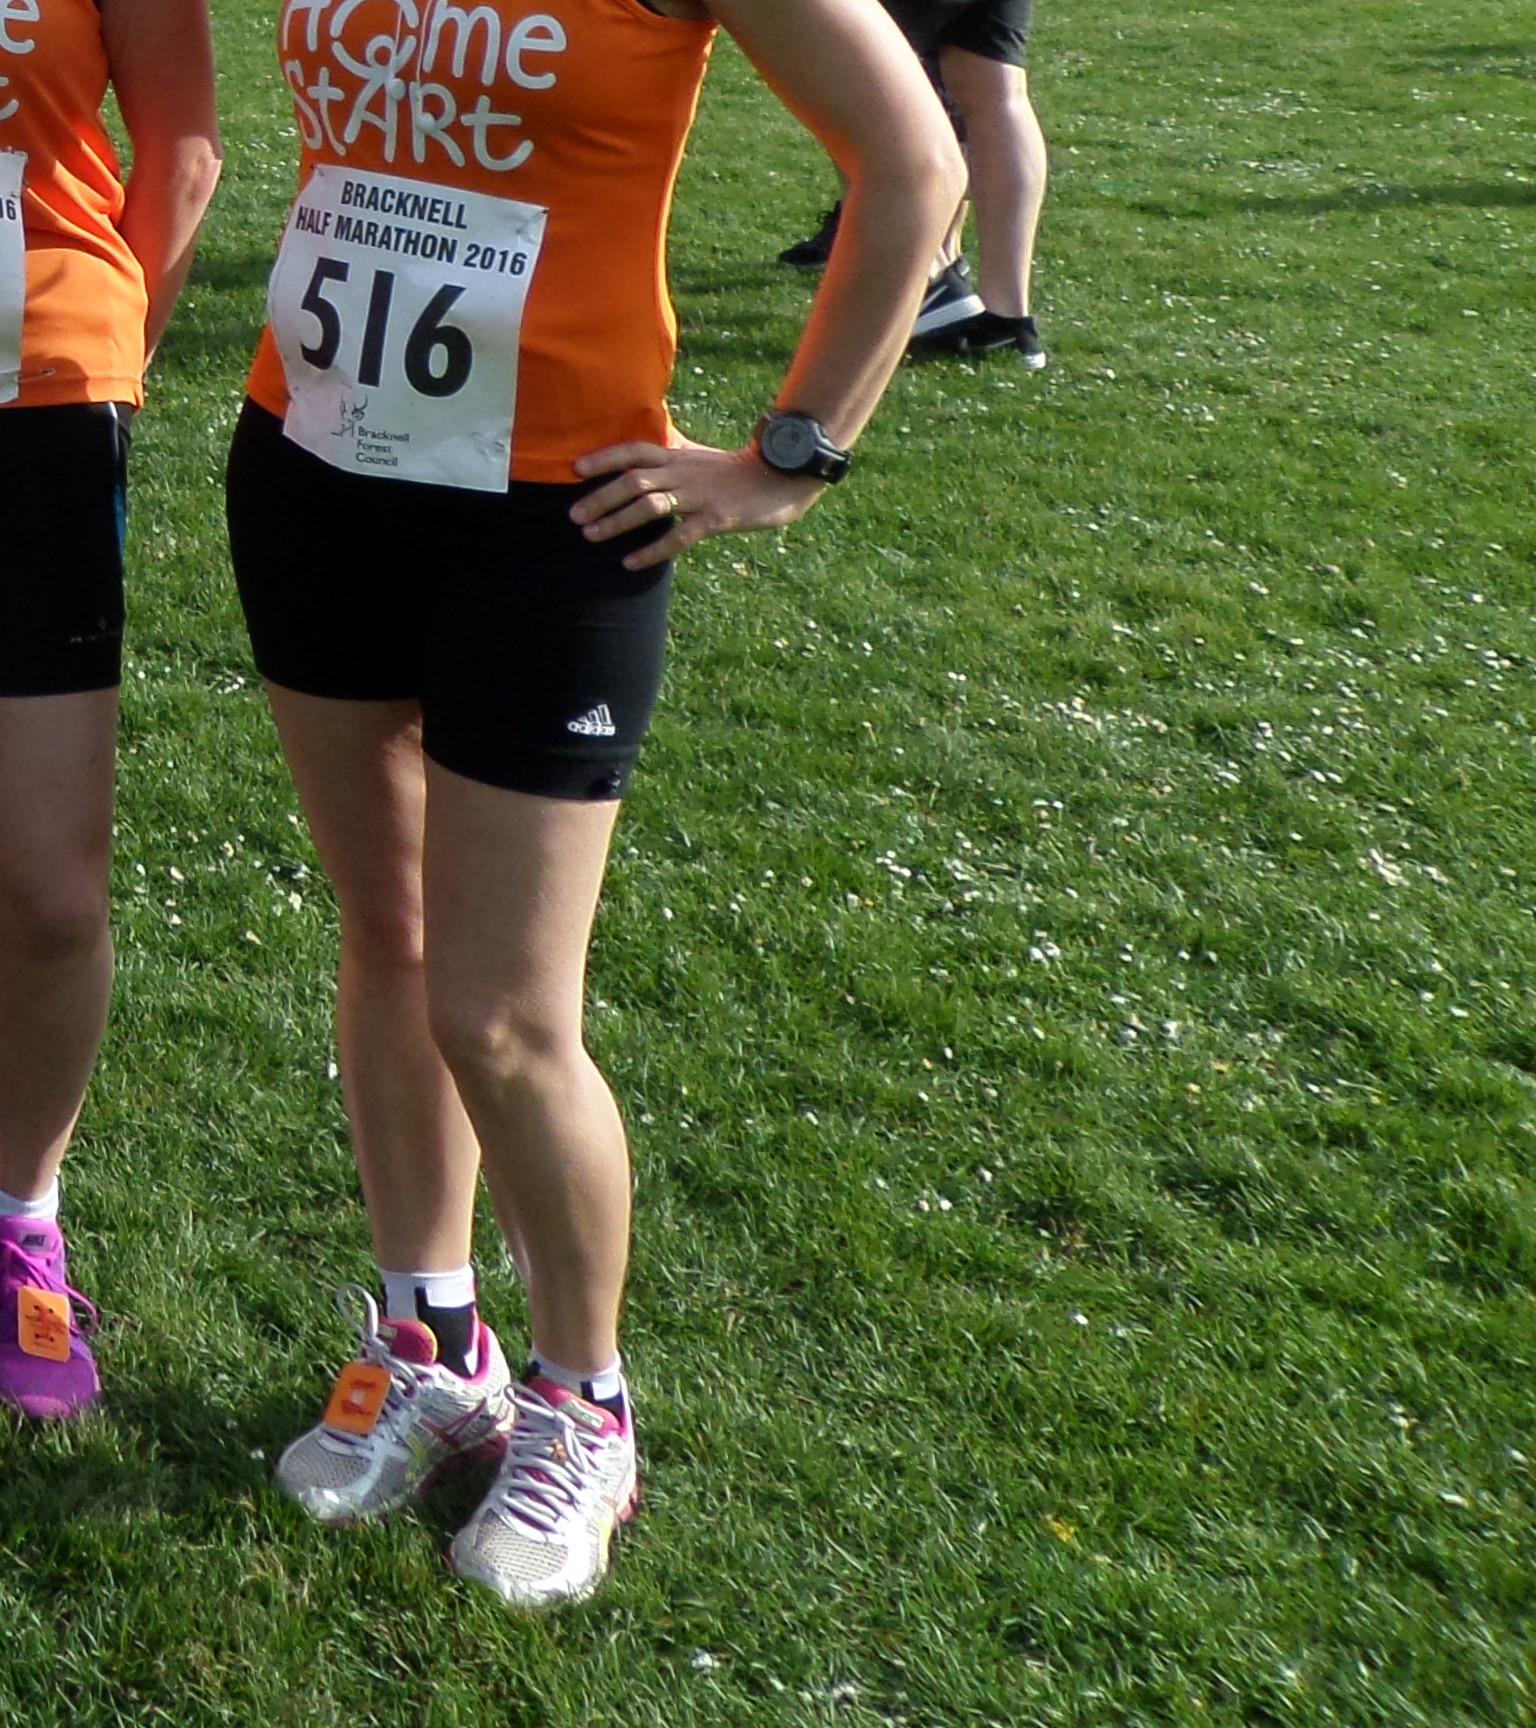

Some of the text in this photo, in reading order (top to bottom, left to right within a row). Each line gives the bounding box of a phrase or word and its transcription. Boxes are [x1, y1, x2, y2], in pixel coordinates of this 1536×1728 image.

[294, 205, 528, 277] HALF MARATHON 2016
[340, 180, 468, 230] BRACKNELL
[299, 256, 474, 399] 516
